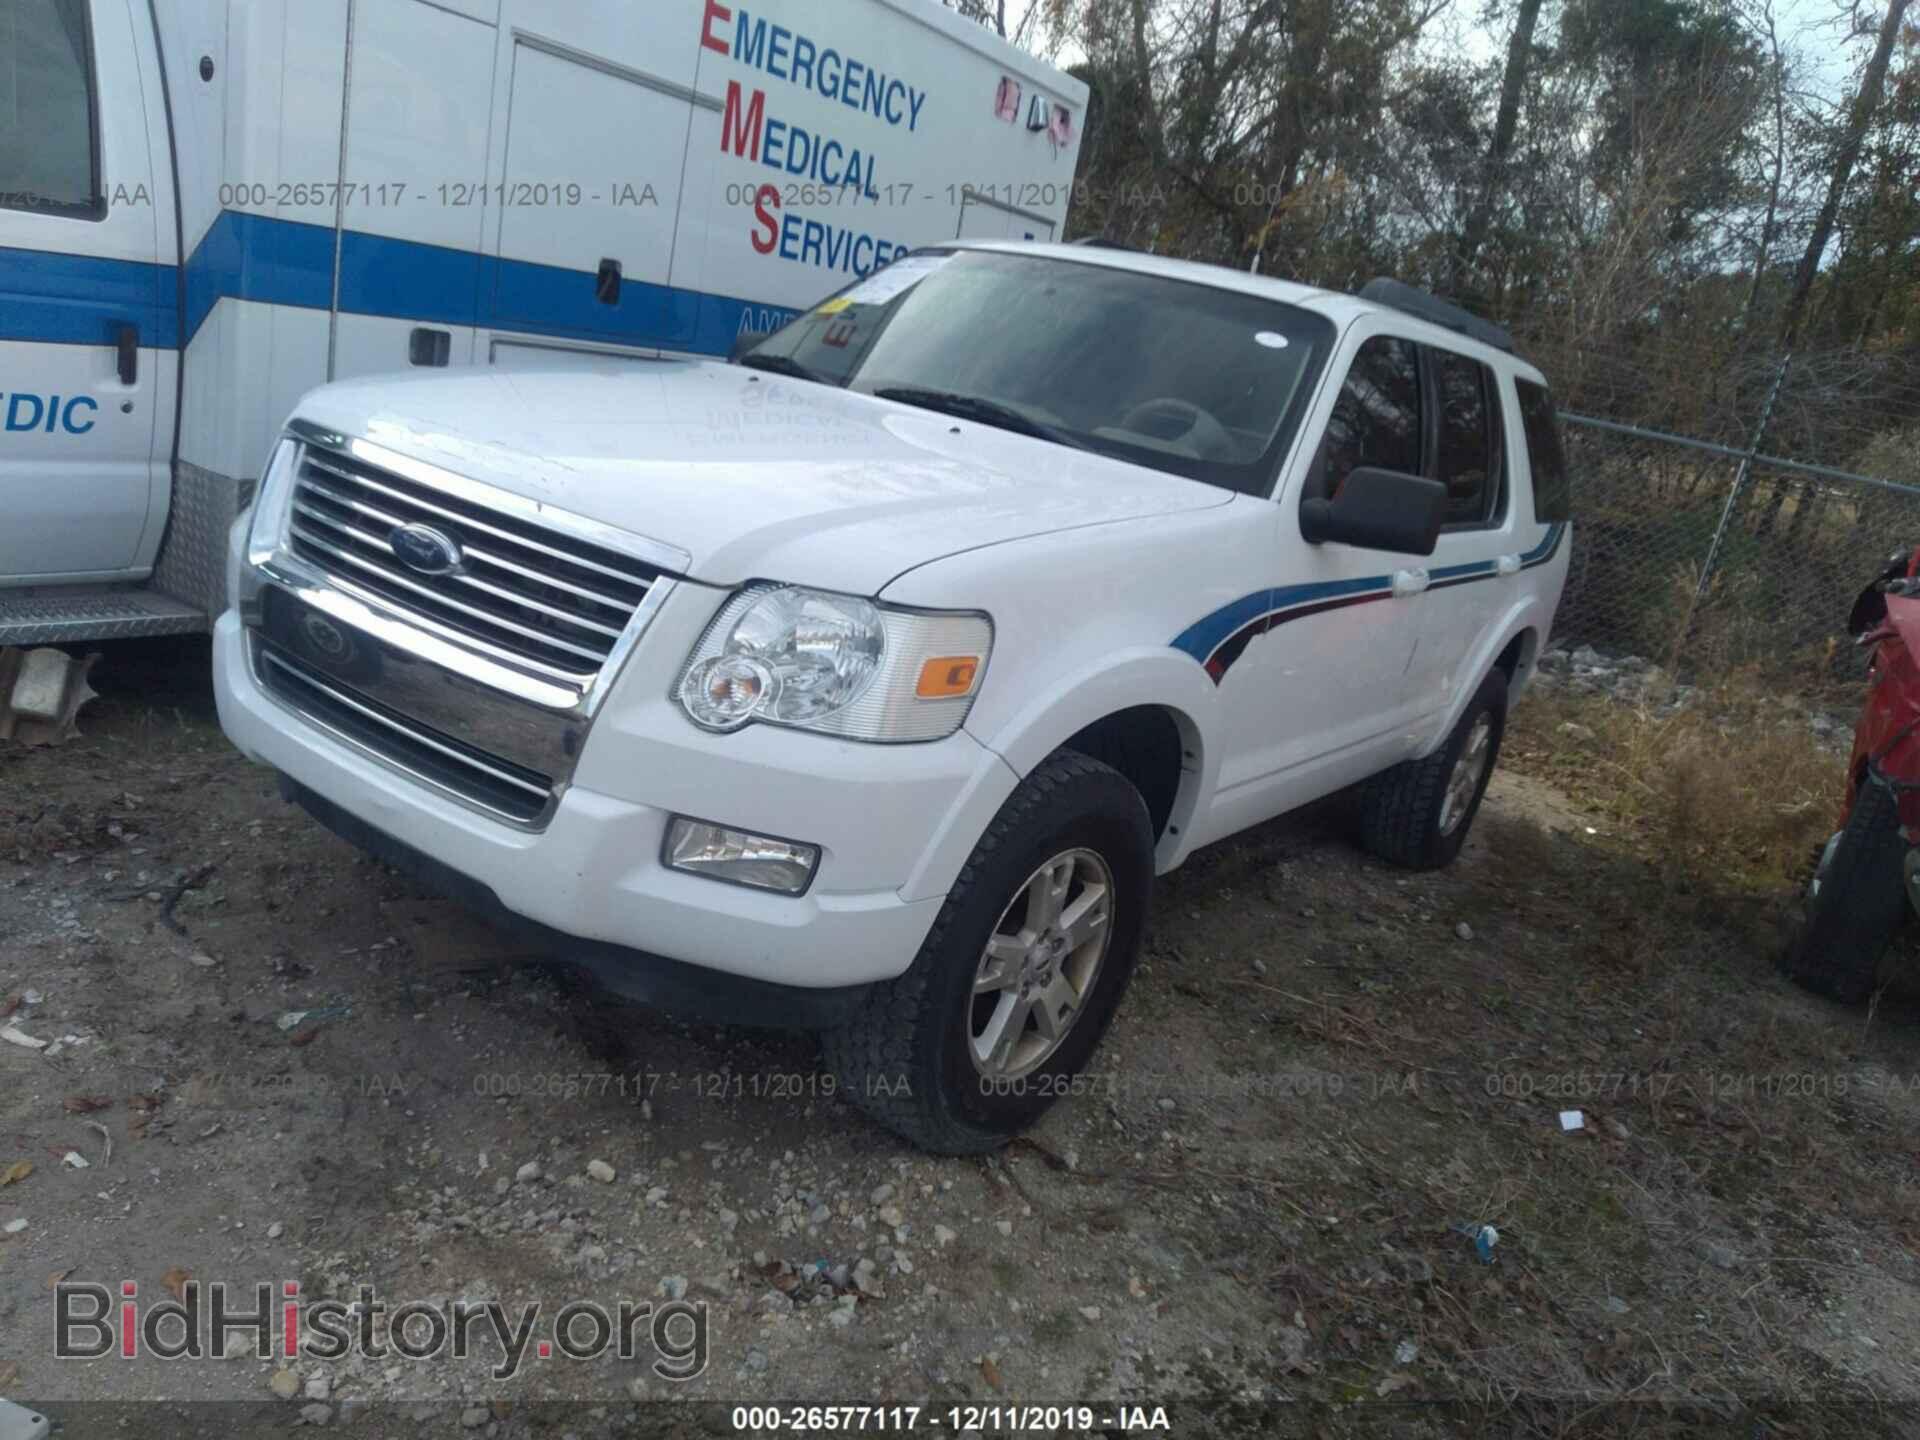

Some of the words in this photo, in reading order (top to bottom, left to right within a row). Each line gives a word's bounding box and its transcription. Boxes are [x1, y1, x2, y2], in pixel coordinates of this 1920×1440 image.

[701, 0, 926, 132] EMERGENCY
[720, 79, 880, 201] MEDICAL
[0, 392, 98, 434] DIC
